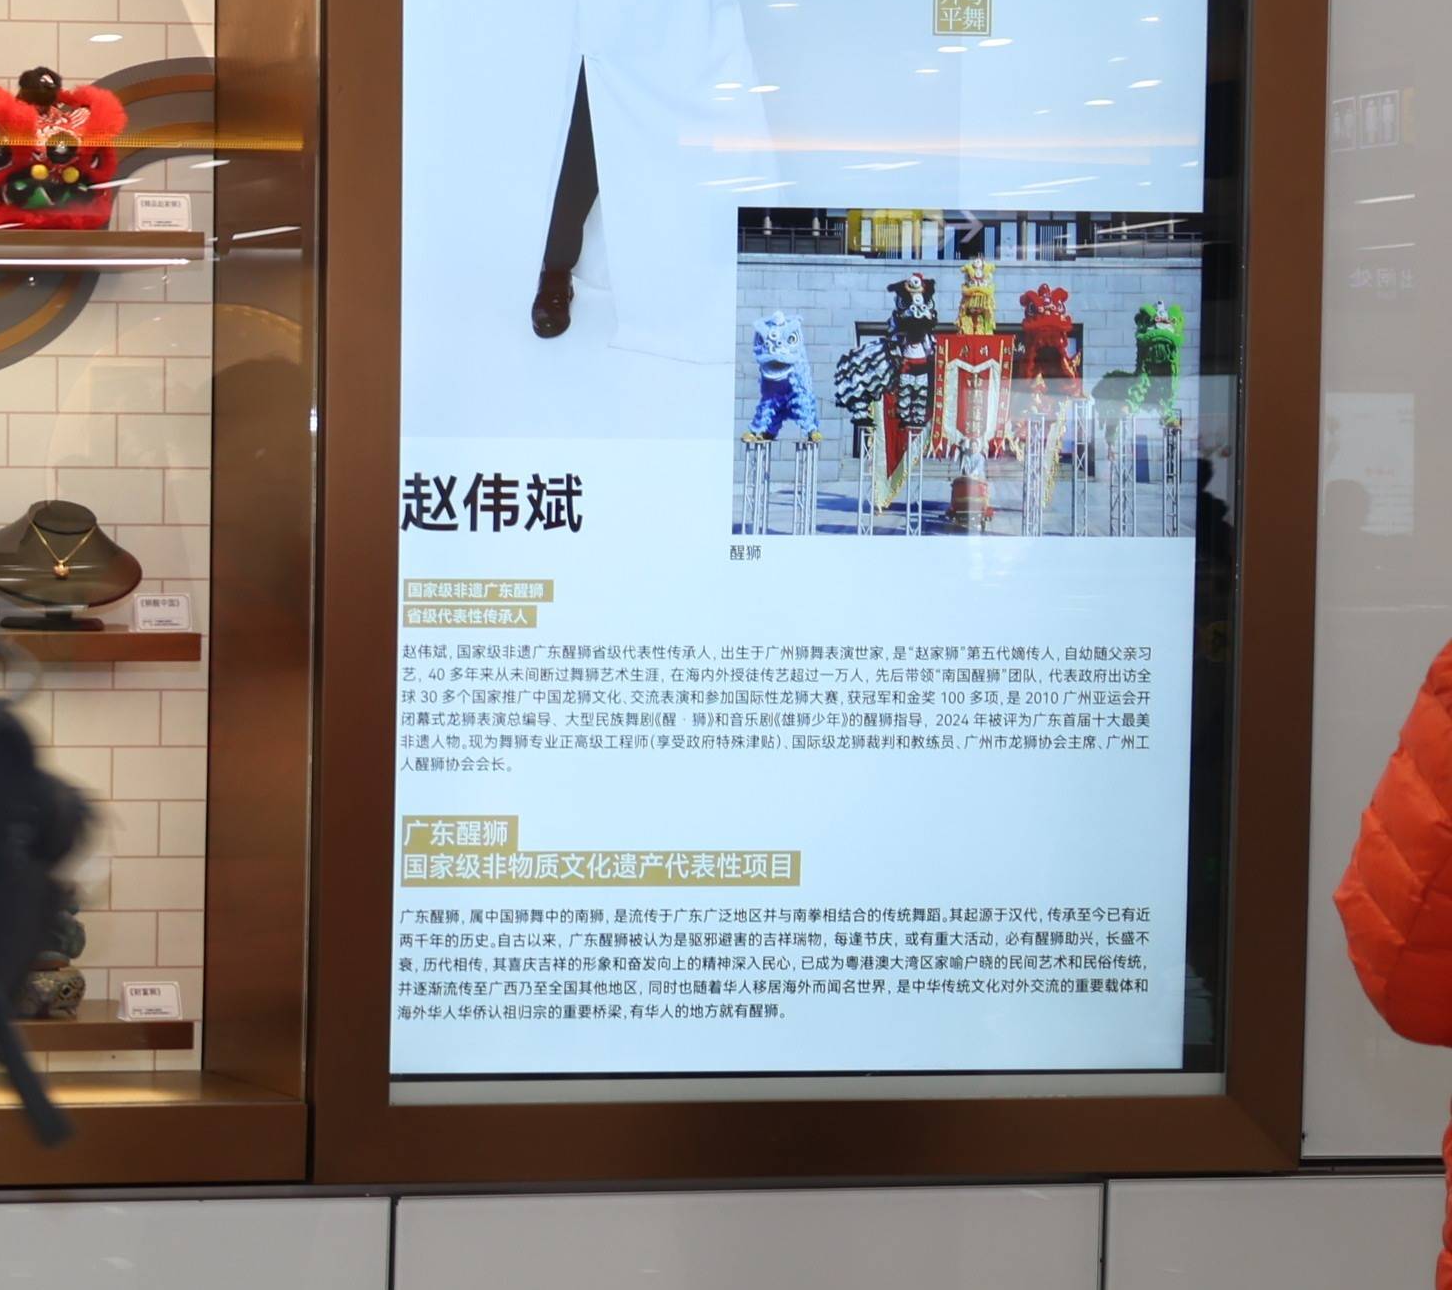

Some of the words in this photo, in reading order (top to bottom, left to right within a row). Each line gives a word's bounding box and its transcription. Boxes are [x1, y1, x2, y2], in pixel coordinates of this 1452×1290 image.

[400, 472, 584, 533] 赵伟斌
[729, 545, 761, 561] 醒狮
[407, 582, 544, 600] 国家级非遗广东醒狮
[407, 608, 528, 625] 省级代表性传承人
[400, 756, 513, 773] 人醒狮协会会长。
[403, 820, 509, 847] 广东醒狮
[402, 852, 793, 880] 国家级非物质文化遗产代表性项目
